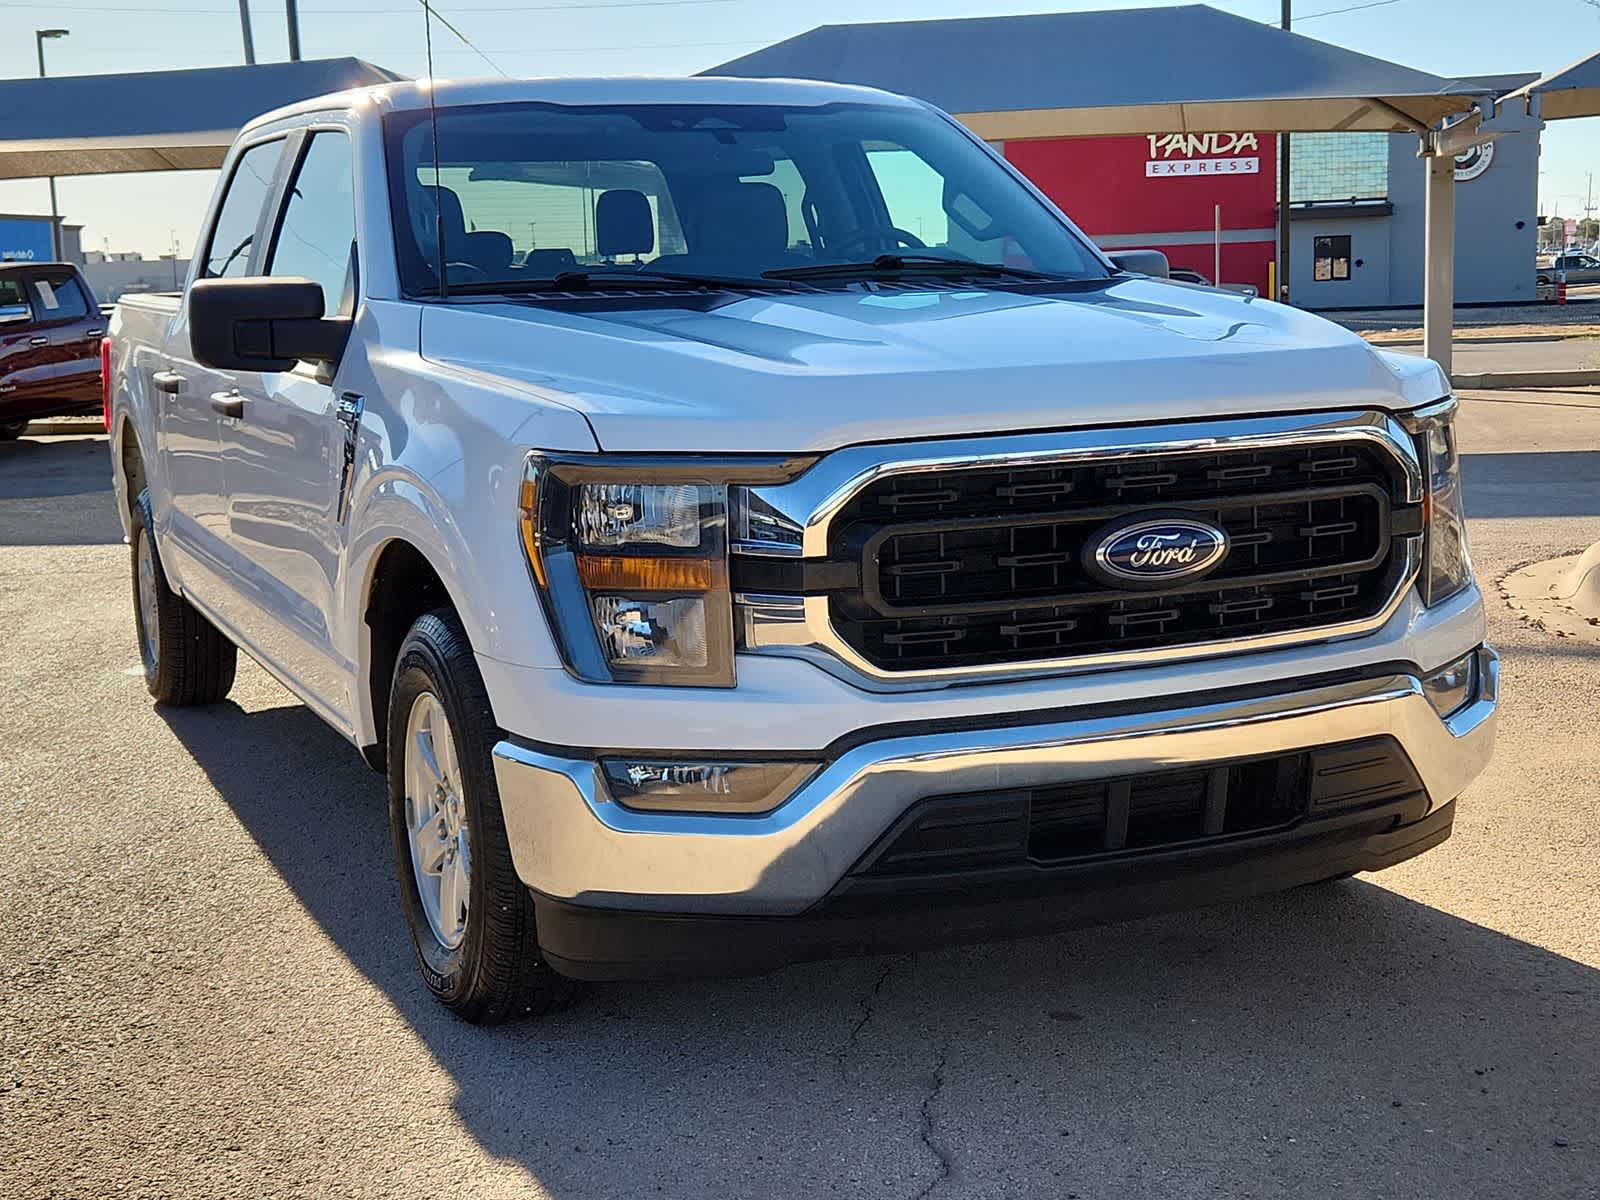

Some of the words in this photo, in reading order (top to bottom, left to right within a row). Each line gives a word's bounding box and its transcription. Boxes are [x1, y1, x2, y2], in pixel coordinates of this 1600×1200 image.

[1147, 133, 1258, 158] PANDA
[1152, 161, 1252, 173] EXPRESS
[1130, 533, 1197, 568] Ford
